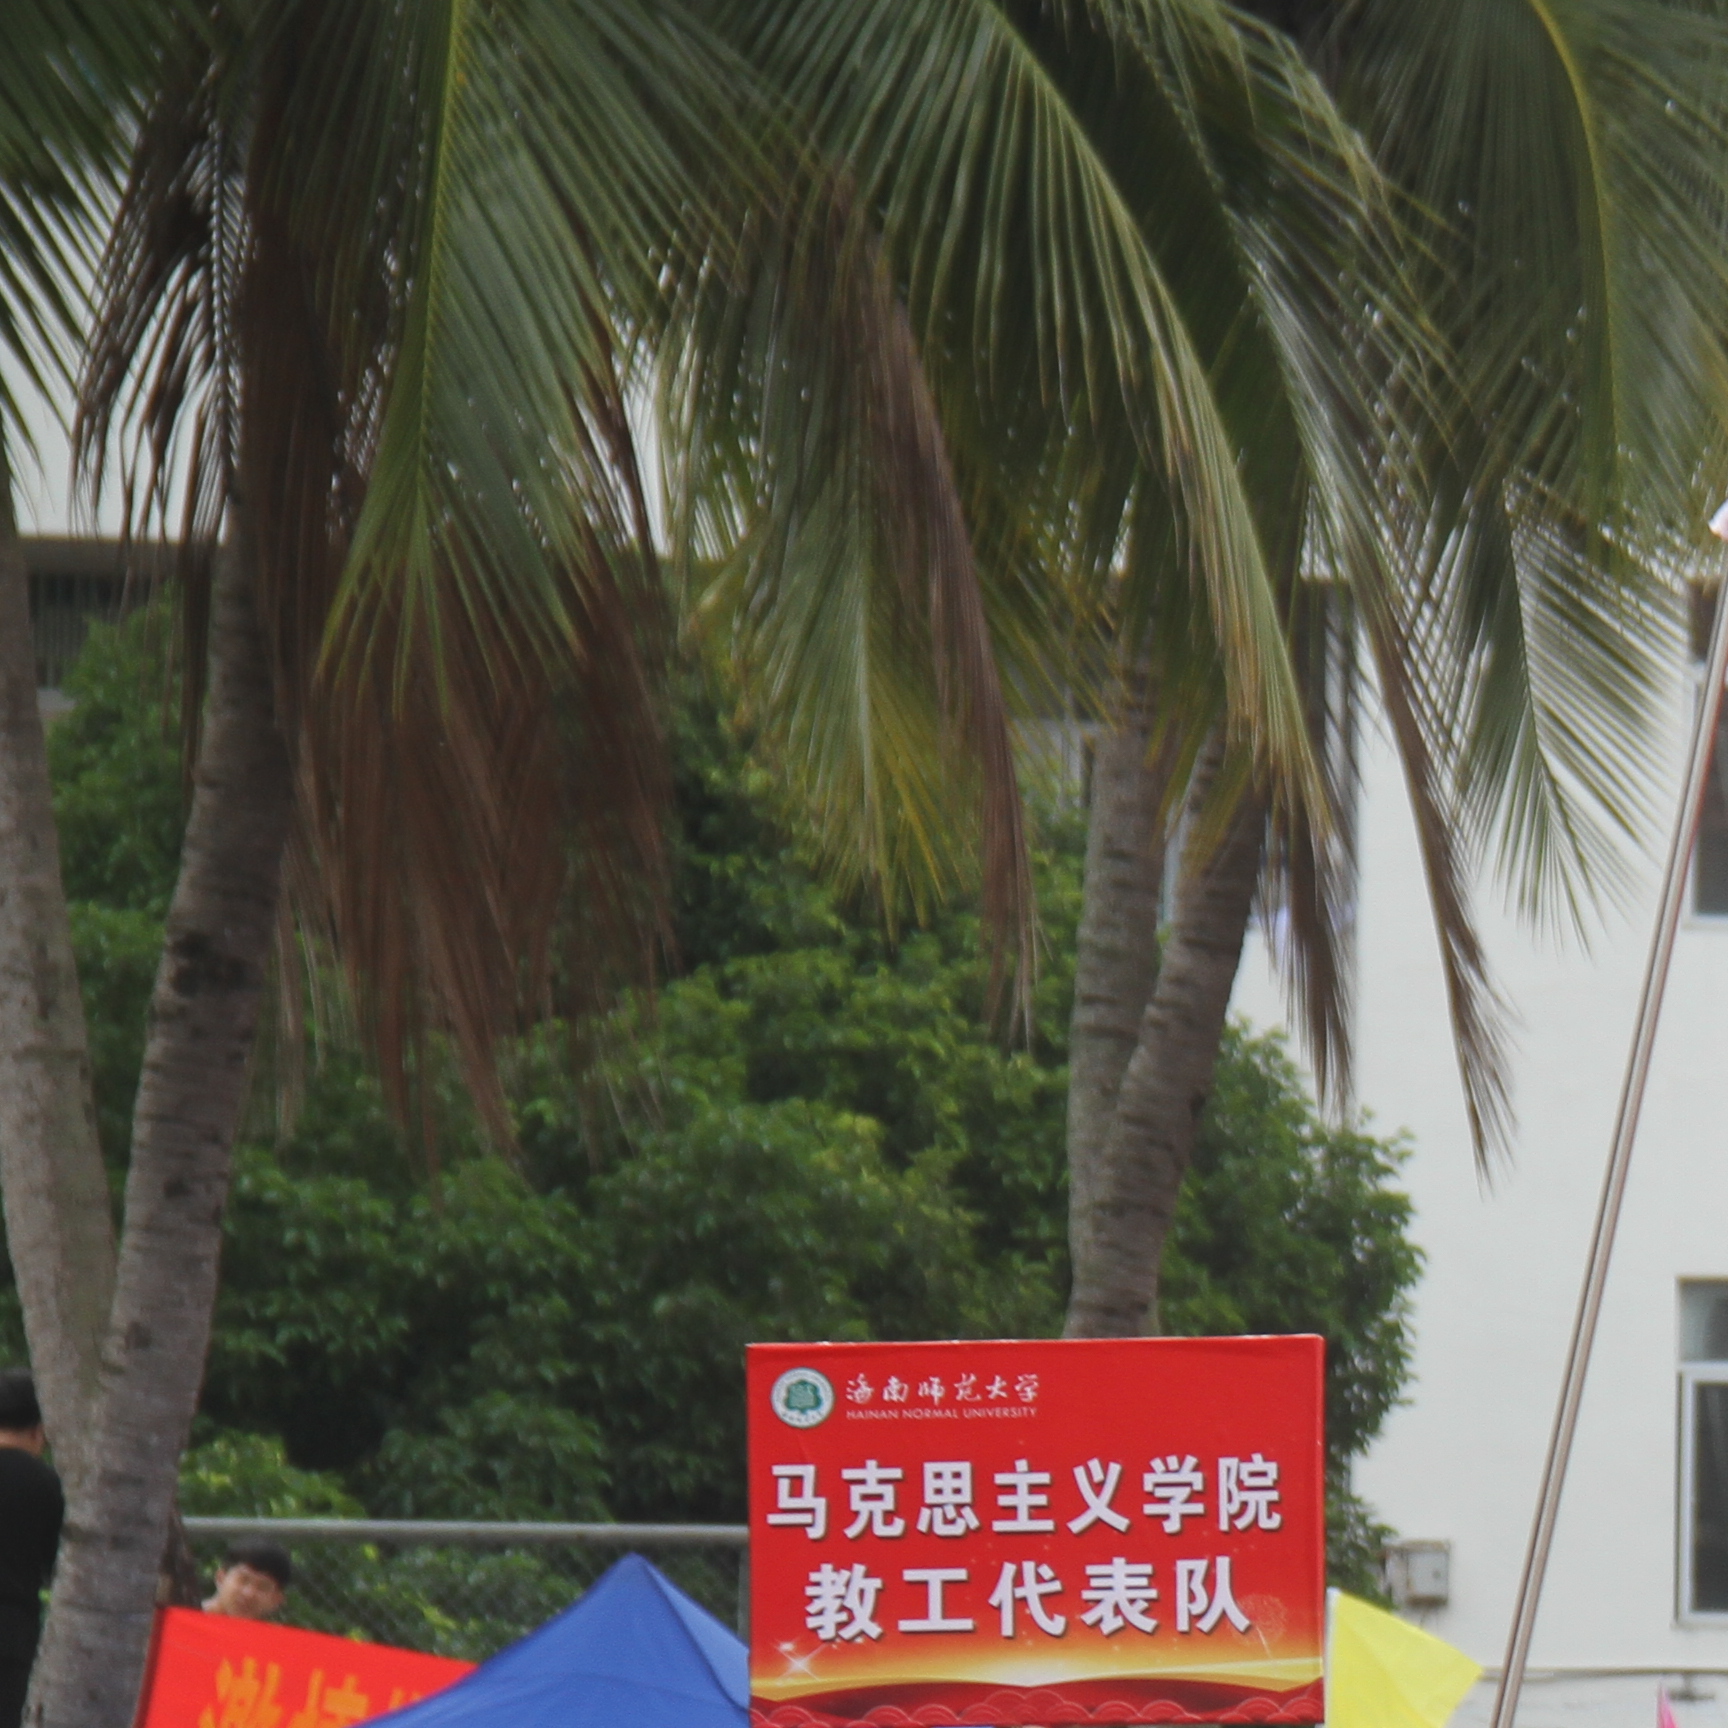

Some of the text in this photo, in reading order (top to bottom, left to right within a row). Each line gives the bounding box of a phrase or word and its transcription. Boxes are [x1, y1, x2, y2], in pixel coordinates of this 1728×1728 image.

[845, 1372, 1040, 1406] 海南师范大学
[846, 1406, 1038, 1420] HAINAN NORMAL UNIVERSITY
[766, 1454, 1283, 1540] 马克思主义学院
[804, 1556, 1252, 1643] 教工代表队
